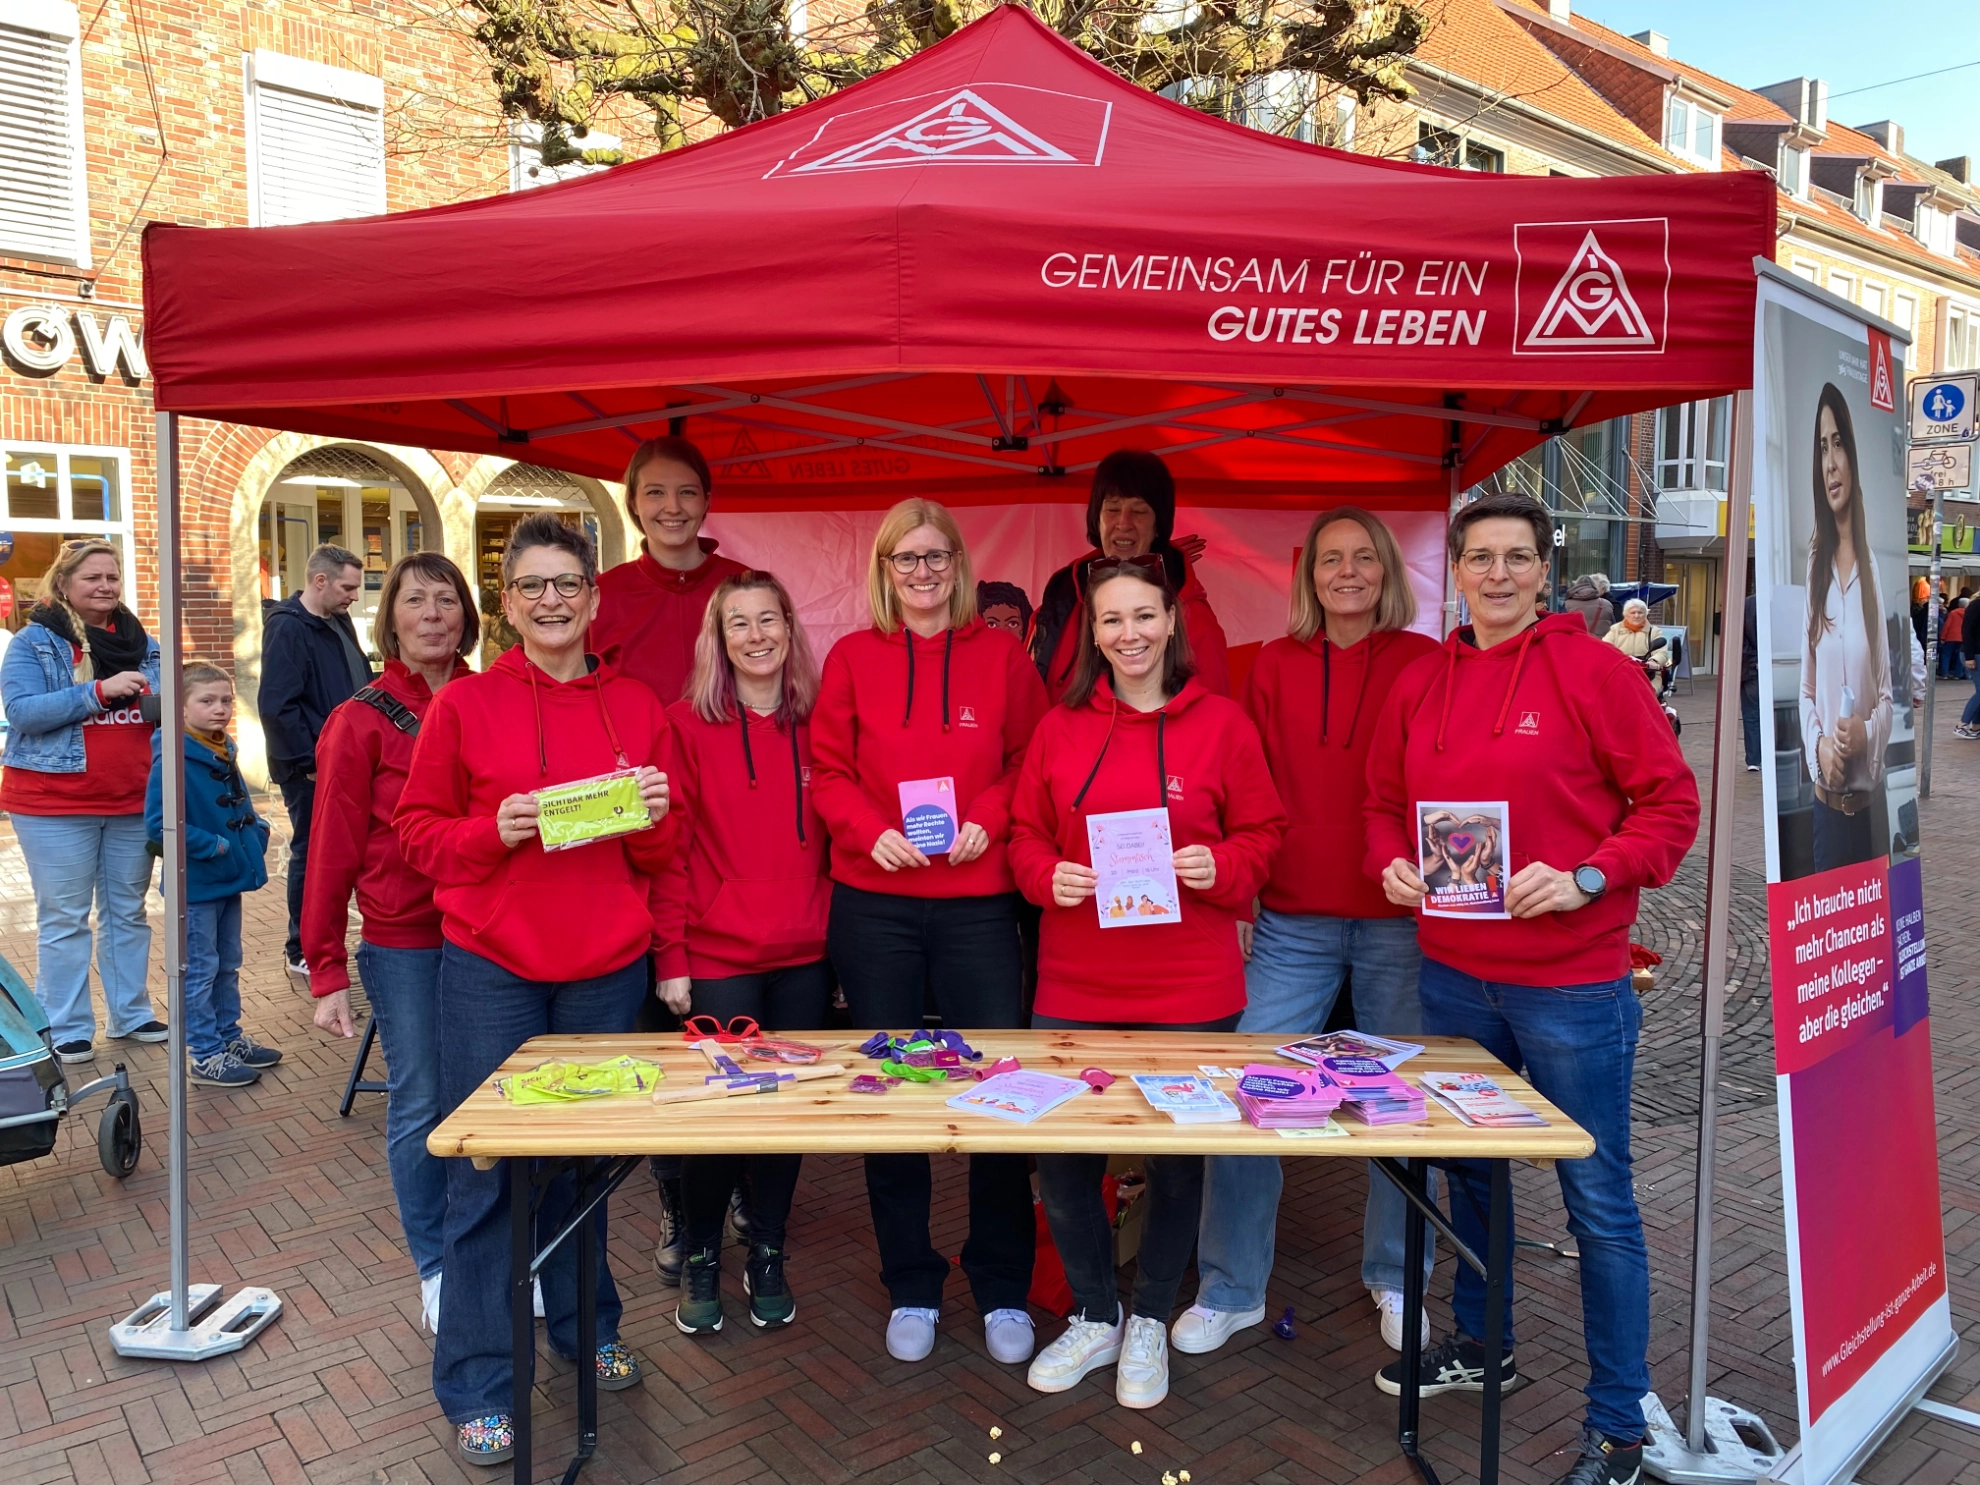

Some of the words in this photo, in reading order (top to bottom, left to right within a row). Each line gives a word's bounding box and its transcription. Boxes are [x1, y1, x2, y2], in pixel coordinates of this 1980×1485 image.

[1041, 252, 1309, 294] GEMEINSAM
[1323, 252, 1404, 295] FÜR
[1416, 260, 1488, 297] EIN
[1207, 306, 1340, 343] GUTES
[1353, 309, 1487, 347] LEBEN
[1926, 423, 1959, 435] ZONE
[1553, 524, 1566, 547] el
[82, 706, 152, 726] dida
[542, 795, 584, 809] SICHTBAR
[585, 790, 609, 801] MEHR
[544, 804, 582, 817] ENTGELT!
[926, 812, 948, 821] Frauen
[907, 828, 932, 837] wollten,
[924, 820, 945, 828] Rechte
[908, 834, 934, 843] meinten
[935, 832, 944, 840] wir
[926, 838, 946, 848] Nazis!
[1430, 891, 1490, 904] DEMOKRATIE
[1434, 886, 1454, 895] WIR
[1455, 882, 1487, 893] LIEBEN
[1787, 900, 1812, 932] „Ich
[1813, 887, 1855, 918] brauche
[1858, 878, 1883, 906] nicht
[1796, 936, 1824, 965] mehr
[1825, 923, 1869, 955] Chancen
[1871, 912, 1885, 939] als
[1797, 975, 1830, 1005] meine
[1799, 1012, 1824, 1044] aber
[1825, 1004, 1839, 1032] die
[1821, 1261, 1937, 1378] www.Gleichstellung-ist-ganze-Arbeit.de
